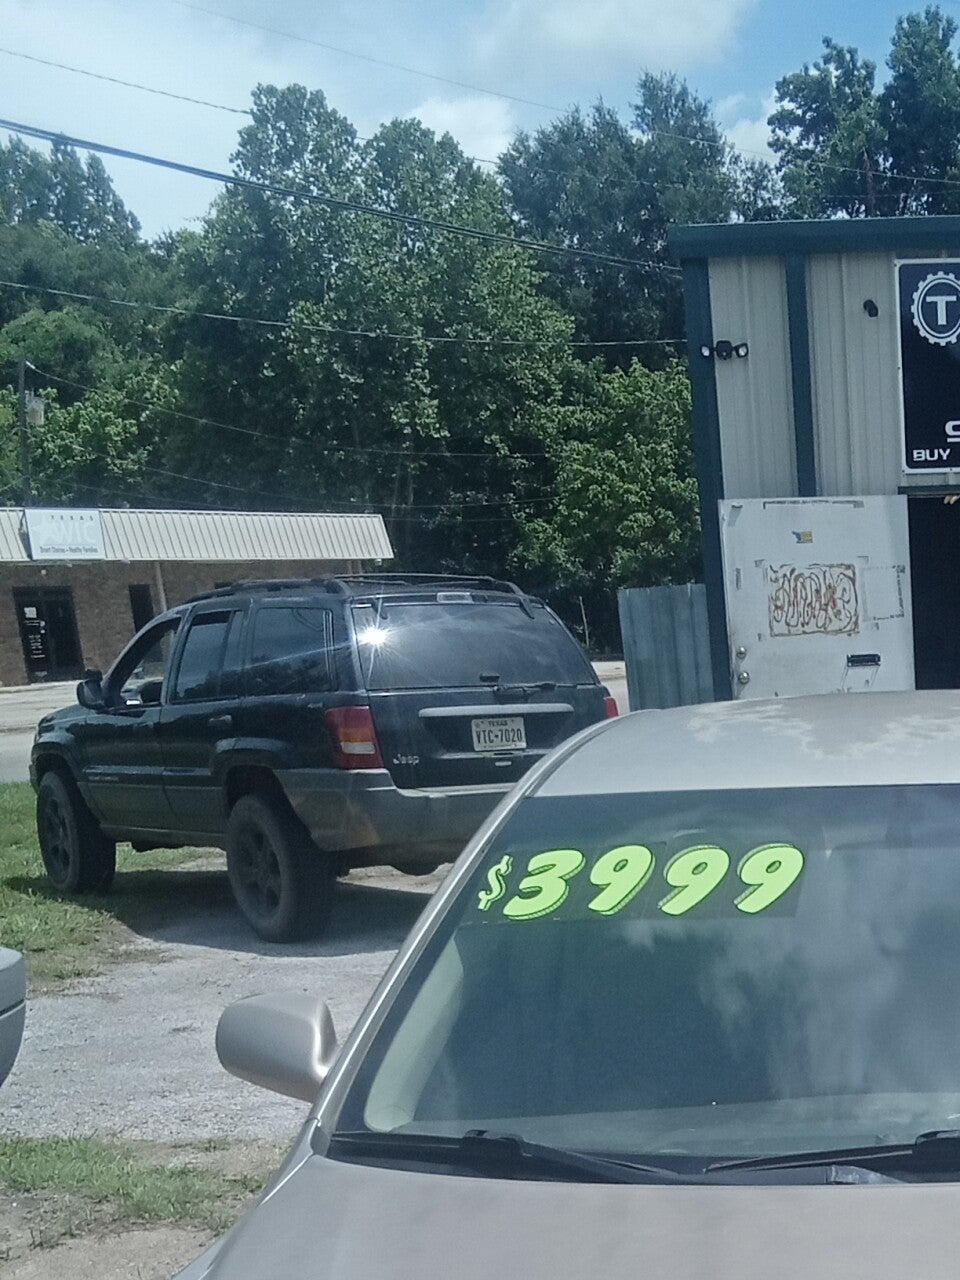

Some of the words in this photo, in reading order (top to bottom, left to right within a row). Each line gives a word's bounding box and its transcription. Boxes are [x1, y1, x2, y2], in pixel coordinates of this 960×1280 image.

[925, 295, 957, 326] T
[912, 449, 951, 462] BUY
[392, 753, 420, 766] Jeep
[477, 843, 804, 921] $3999
